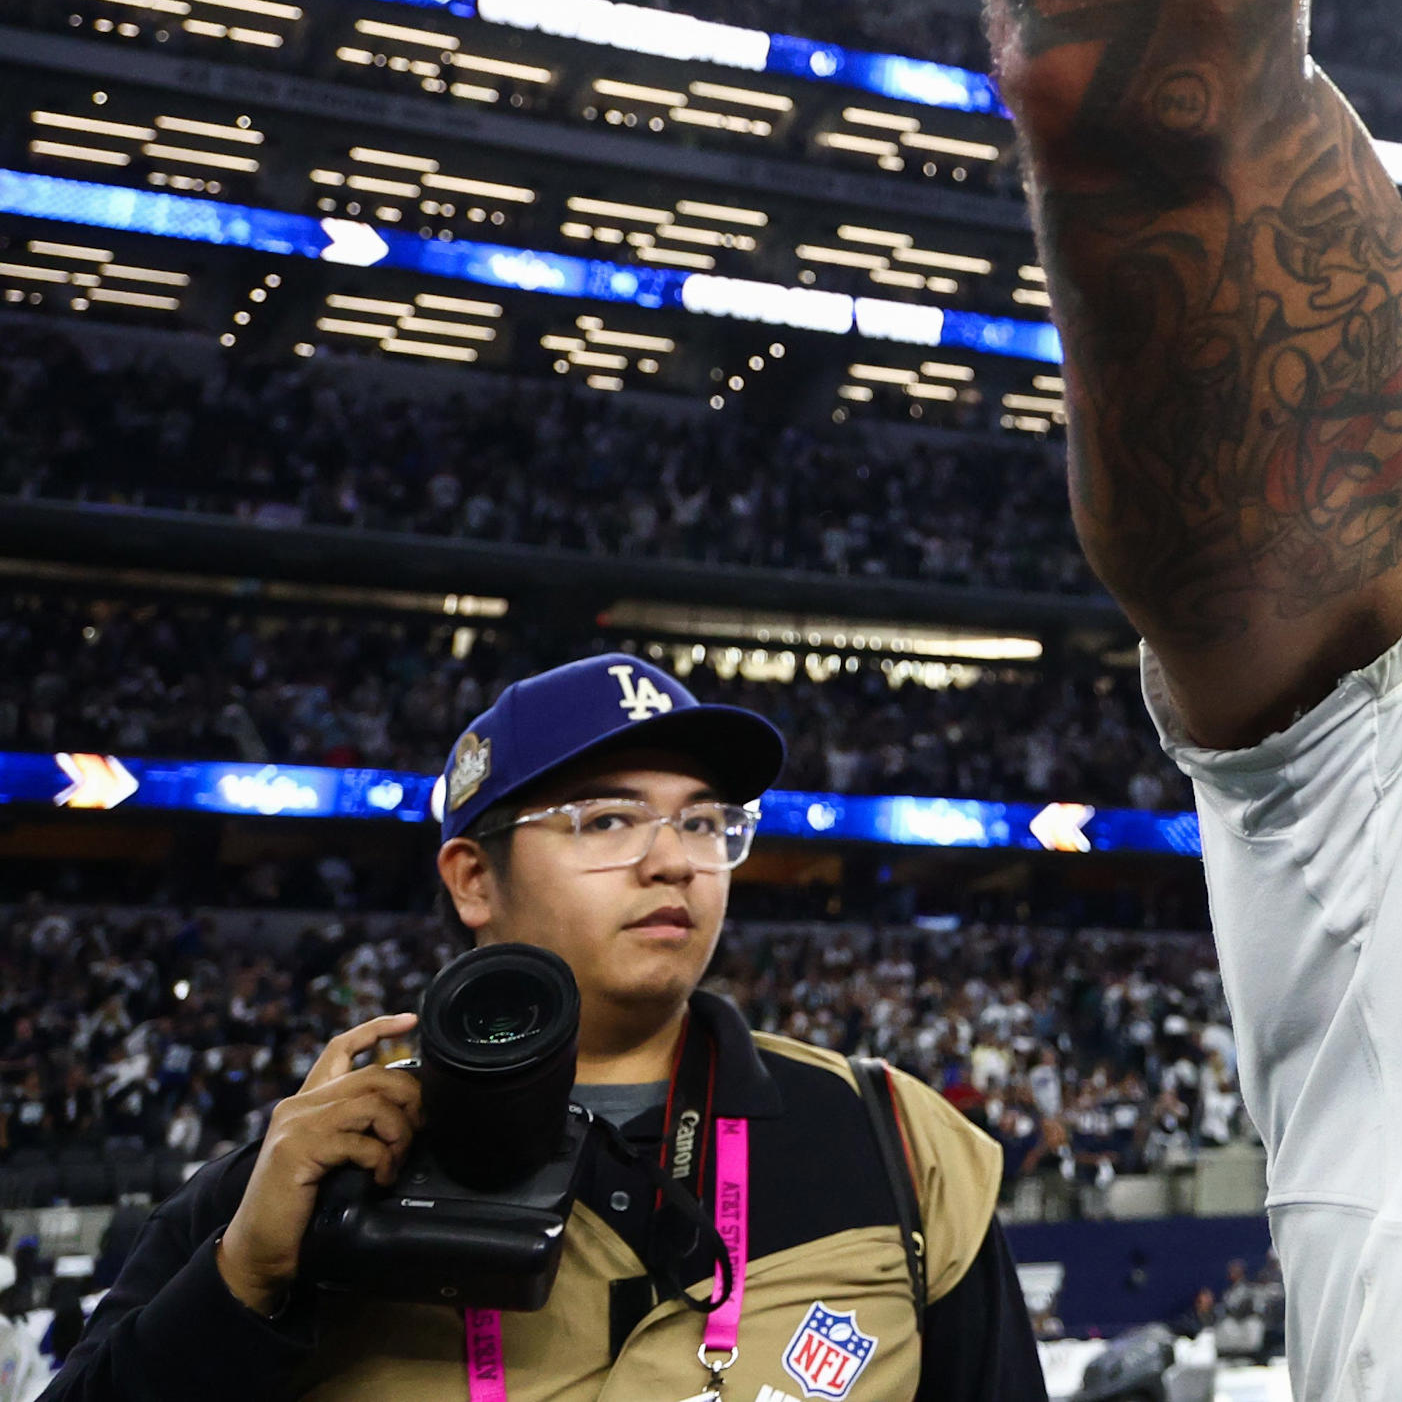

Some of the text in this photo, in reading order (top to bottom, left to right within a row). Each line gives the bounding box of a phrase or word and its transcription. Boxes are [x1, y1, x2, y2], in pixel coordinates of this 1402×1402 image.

[607, 664, 673, 720] LA
[672, 1109, 700, 1179] Canon
[721, 1181, 740, 1221] AT&T
[793, 1333, 851, 1390] NFL
